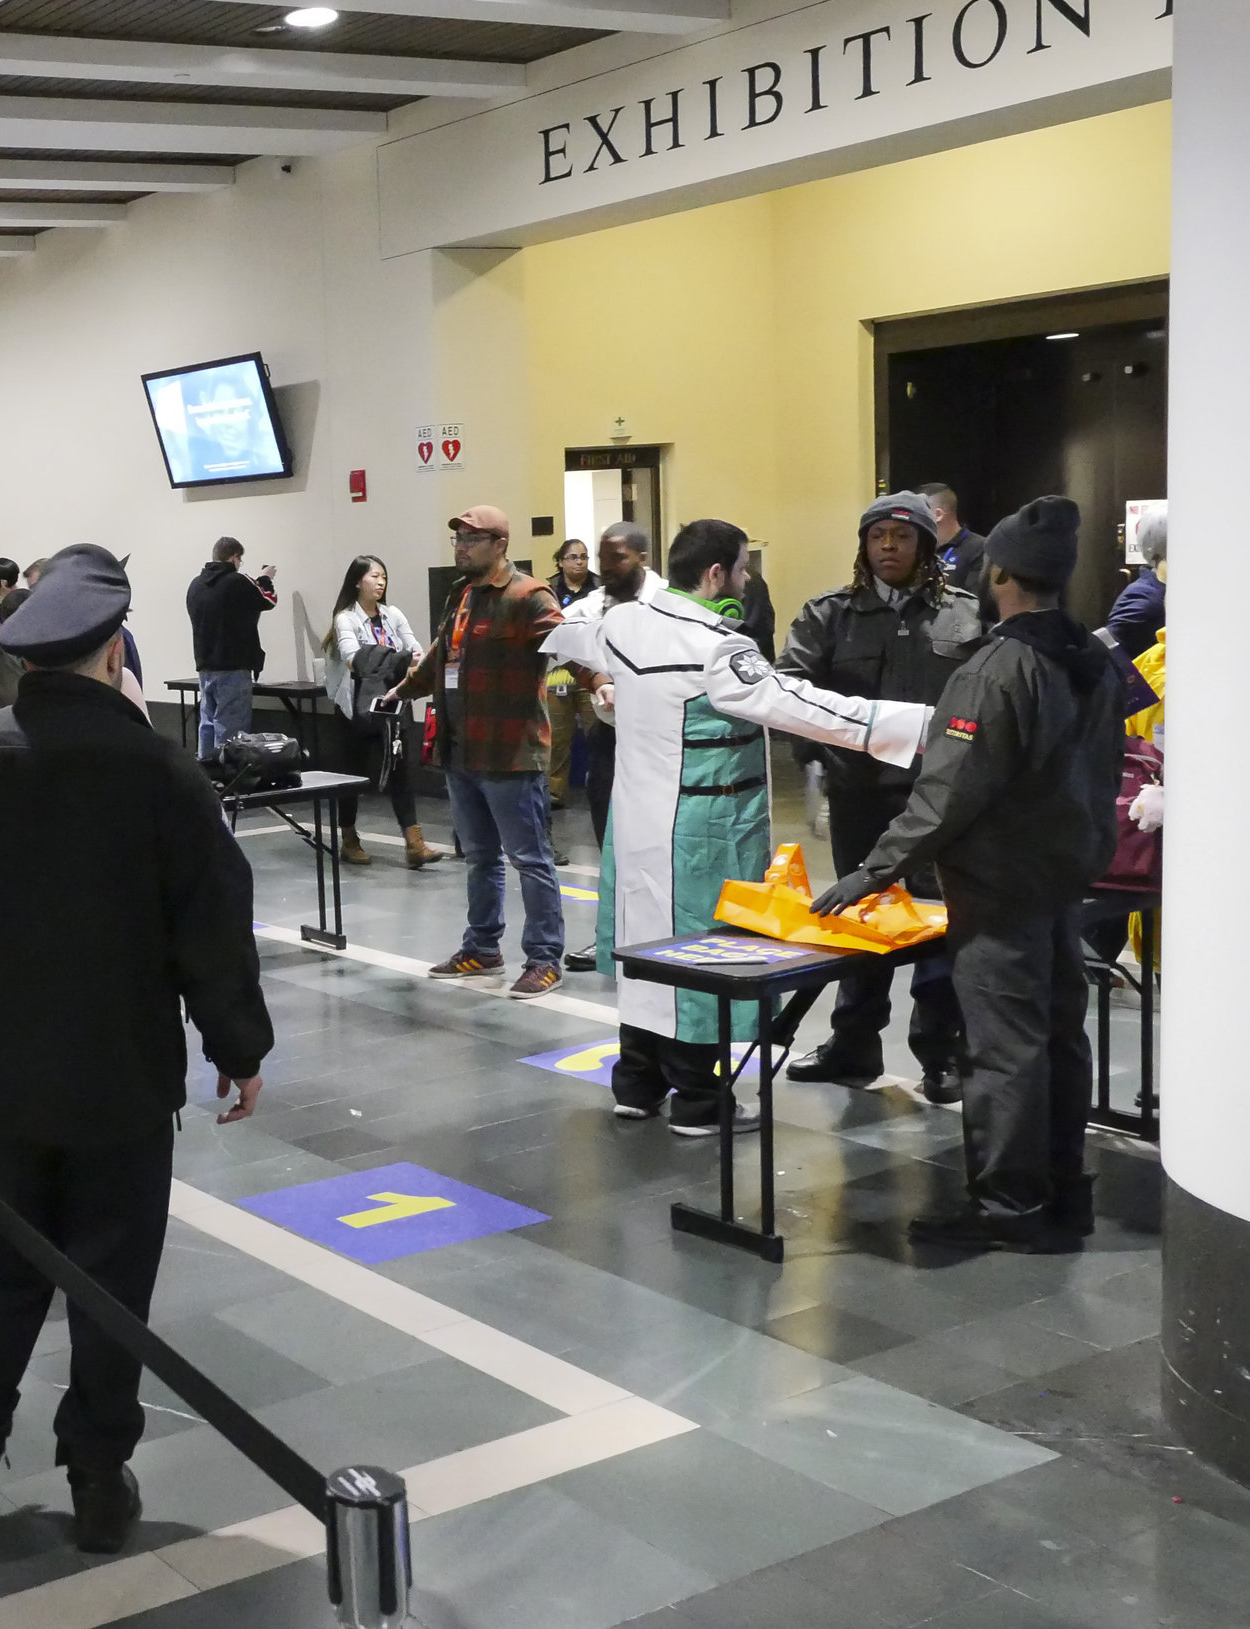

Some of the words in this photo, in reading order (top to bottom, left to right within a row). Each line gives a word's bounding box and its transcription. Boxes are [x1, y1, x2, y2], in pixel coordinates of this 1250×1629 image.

[538, 0, 1091, 185] EXHIBITION
[417, 428, 432, 438] AED
[442, 426, 460, 436] AED
[700, 937, 804, 958] PLACE
[336, 1191, 457, 1229] 1
